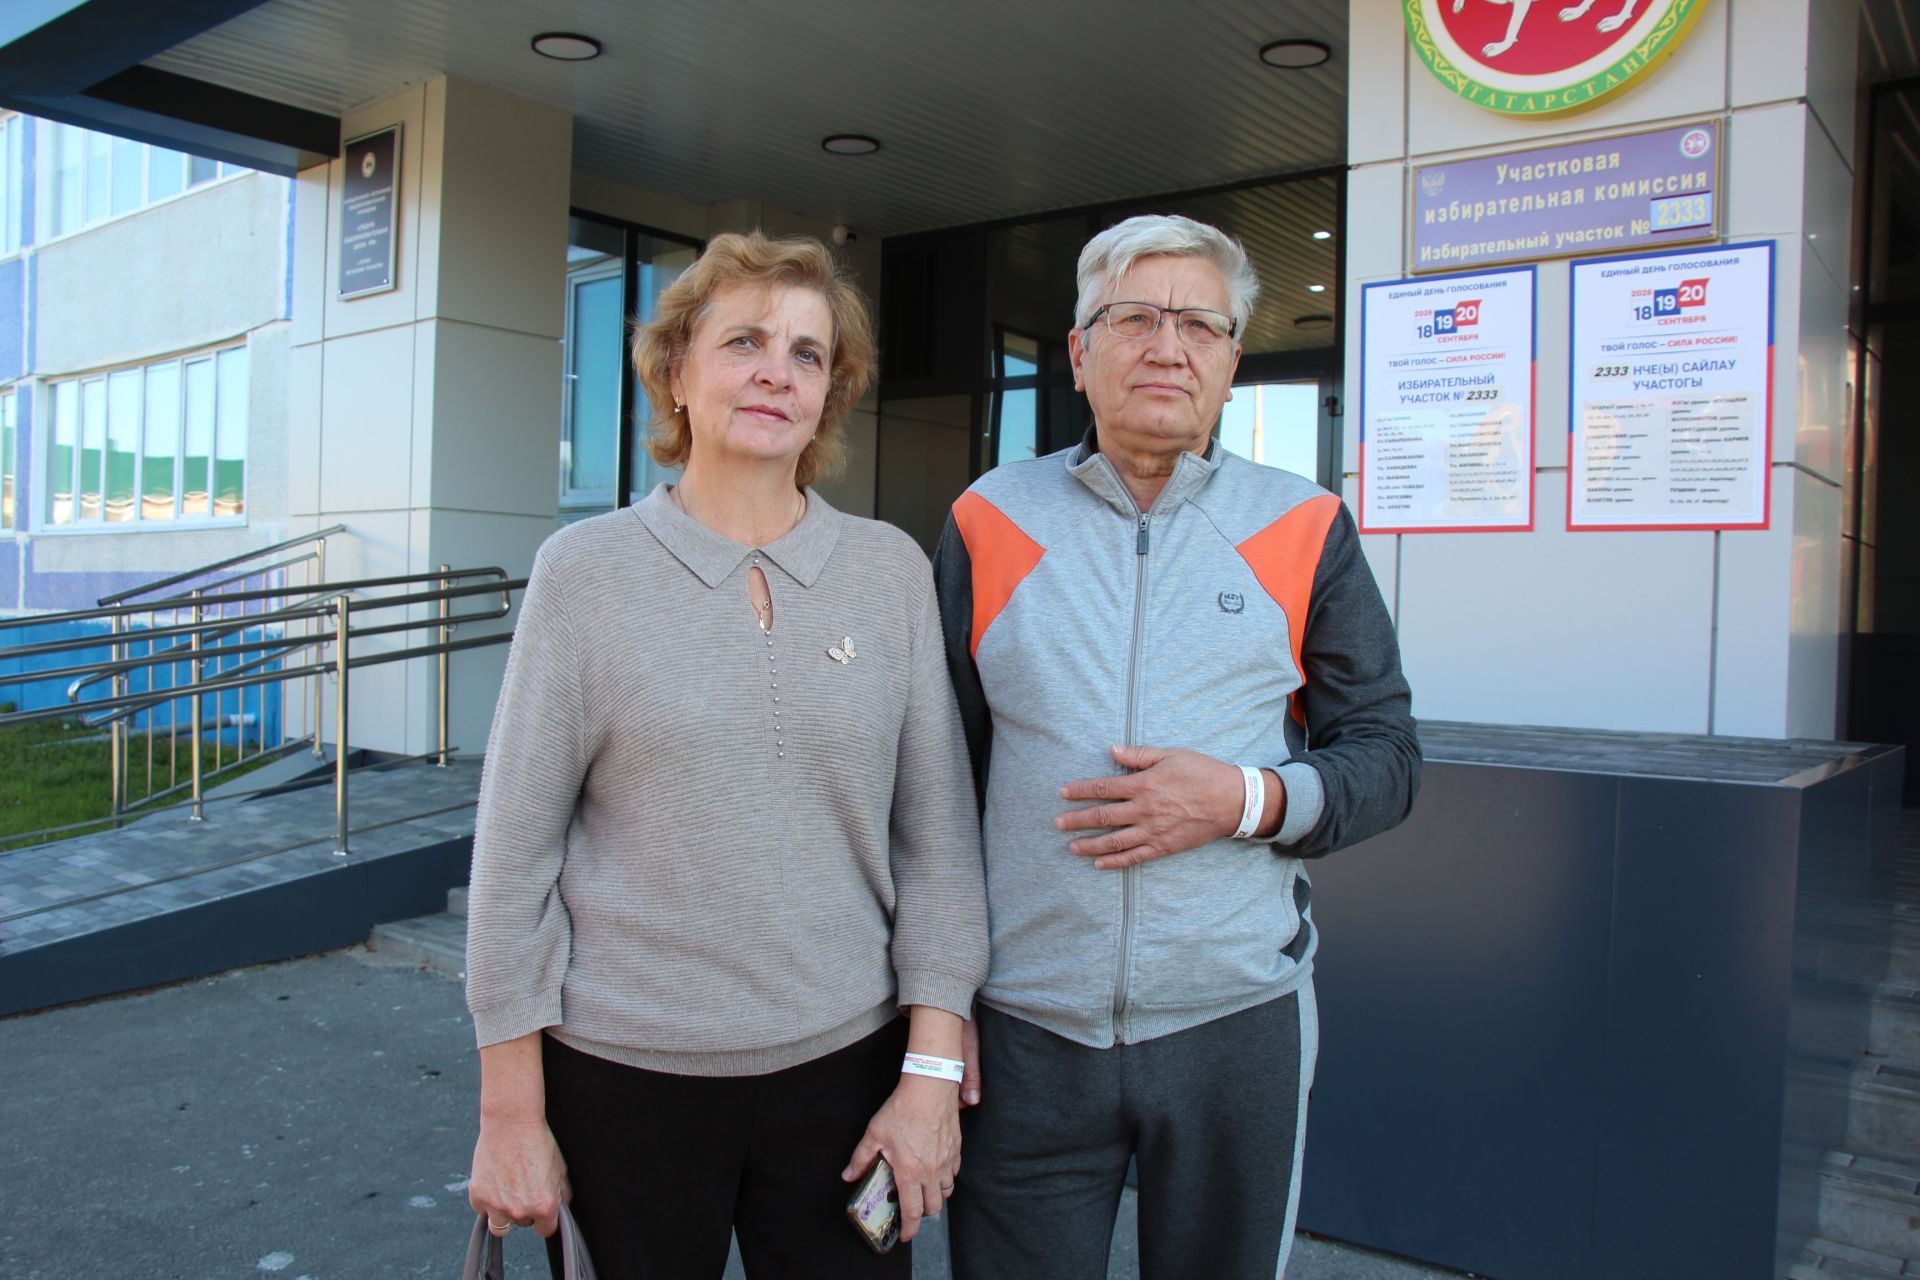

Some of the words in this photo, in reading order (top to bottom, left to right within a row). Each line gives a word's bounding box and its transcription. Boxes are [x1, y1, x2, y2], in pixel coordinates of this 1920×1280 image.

[1468, 55, 1640, 111] ТАТАРСТАН
[1496, 152, 1621, 185] Участковая
[1424, 188, 1585, 225] избирательная
[1595, 171, 1707, 201] комиссия
[1421, 231, 1550, 261] Избирательный
[1555, 225, 1624, 248] участок
[1657, 198, 1706, 226] 2333
[1601, 266, 1640, 278] ЕДИНЫЙ
[1641, 266, 1667, 275] ДЕНЬ
[1668, 257, 1740, 271] ГОЛОСОВАНИЯ
[1388, 288, 1422, 300] ЕДИНЫЙ
[1424, 287, 1445, 296] ДЕНЬ
[1446, 280, 1508, 293] ГОЛОСОВАНИЯ
[1633, 305, 1653, 321] 18
[1656, 294, 1677, 312] 19
[1679, 284, 1704, 302] 20
[1416, 325, 1433, 338] 18
[1435, 314, 1454, 330] 19
[1456, 305, 1477, 321] 20
[1657, 315, 1707, 326] СЕНТЯБРЯ
[1438, 333, 1480, 343] СЕНТЯБРЯ
[1601, 343, 1625, 352] ТВОЙ
[1627, 341, 1657, 350] ГОЛОС
[1667, 339, 1693, 348] СИЛА
[1695, 335, 1738, 345] РОССИИ!
[1388, 359, 1409, 367] ТВОЙ
[1411, 357, 1437, 366] ГОЛОС
[1446, 355, 1468, 364] СИЛА
[1469, 352, 1506, 361] РОССИИ!
[1594, 366, 1629, 377] 2333
[1633, 363, 1679, 376] НЧЕ(Ы)
[1682, 359, 1737, 373] САЙЛАУ
[1398, 372, 1495, 391] ИЗБИРАТЕЛЬНЫЙ
[1633, 377, 1703, 391] УЧАСТОГЫ
[1400, 392, 1450, 405] УЧАСТОК
[1466, 389, 1499, 401] 2333
